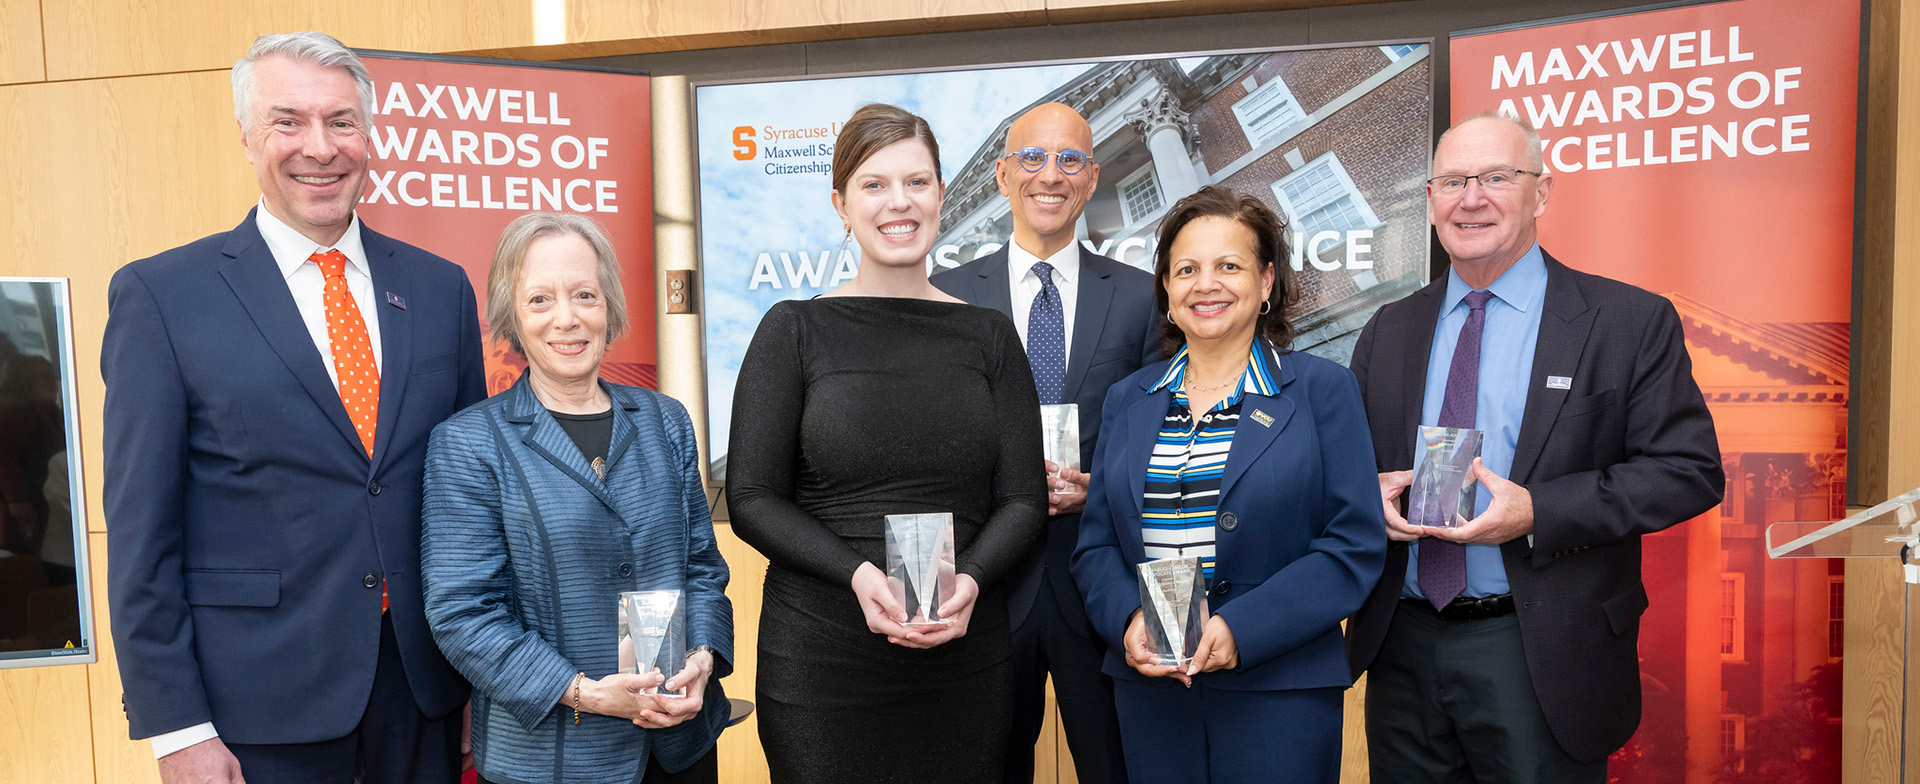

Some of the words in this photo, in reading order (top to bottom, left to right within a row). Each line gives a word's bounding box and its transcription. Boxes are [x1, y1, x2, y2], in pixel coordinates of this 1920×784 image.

[1490, 25, 1754, 90] MAXWELL
[1727, 66, 1802, 110] OF
[368, 125, 542, 168] WARDS
[550, 135, 609, 170] OF
[763, 125, 829, 144] Syracuse
[764, 144, 817, 159] Maxwell
[1541, 113, 1810, 173] CELLENCE
[764, 160, 832, 176] Citizenship
[359, 169, 619, 213] XCELLENCE
